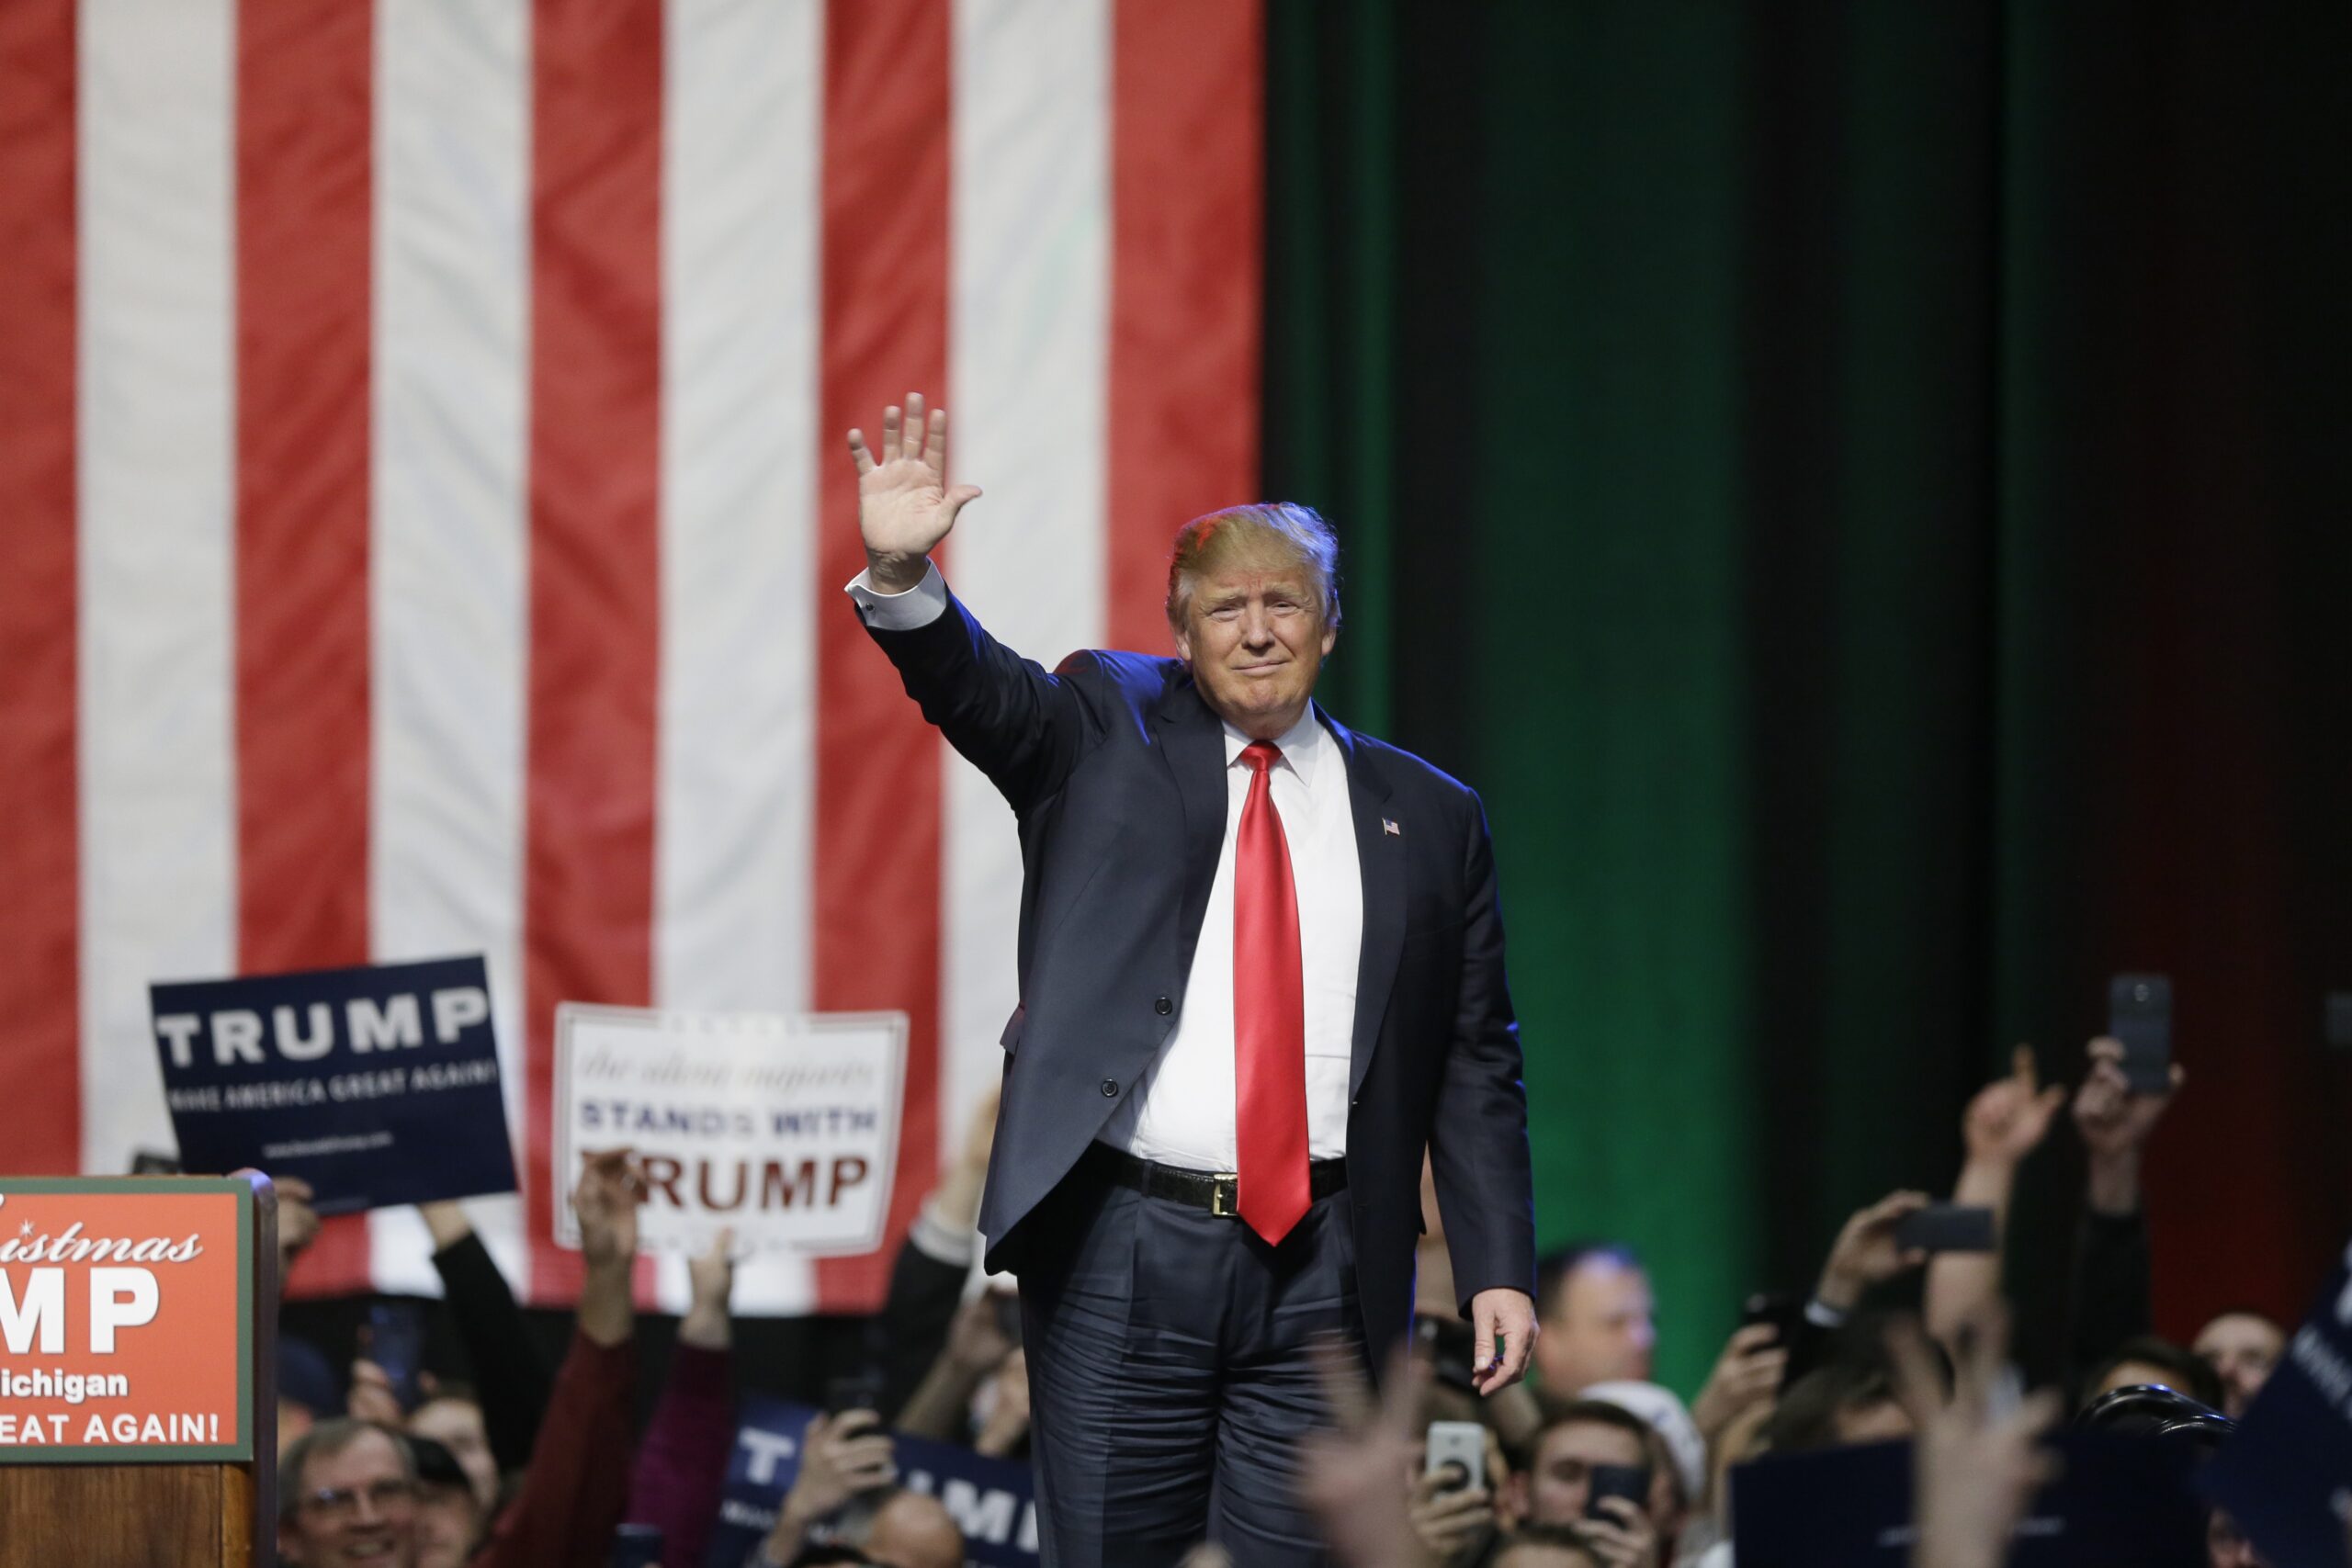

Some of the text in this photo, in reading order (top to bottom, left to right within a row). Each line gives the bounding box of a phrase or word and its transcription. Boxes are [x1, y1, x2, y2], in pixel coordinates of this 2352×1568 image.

[155, 986, 489, 1067] TRUMP
[580, 1099, 877, 1137] STANDS WITH
[638, 1154, 869, 1213] RUMP
[83, 1413, 219, 1444] AGAIN!
